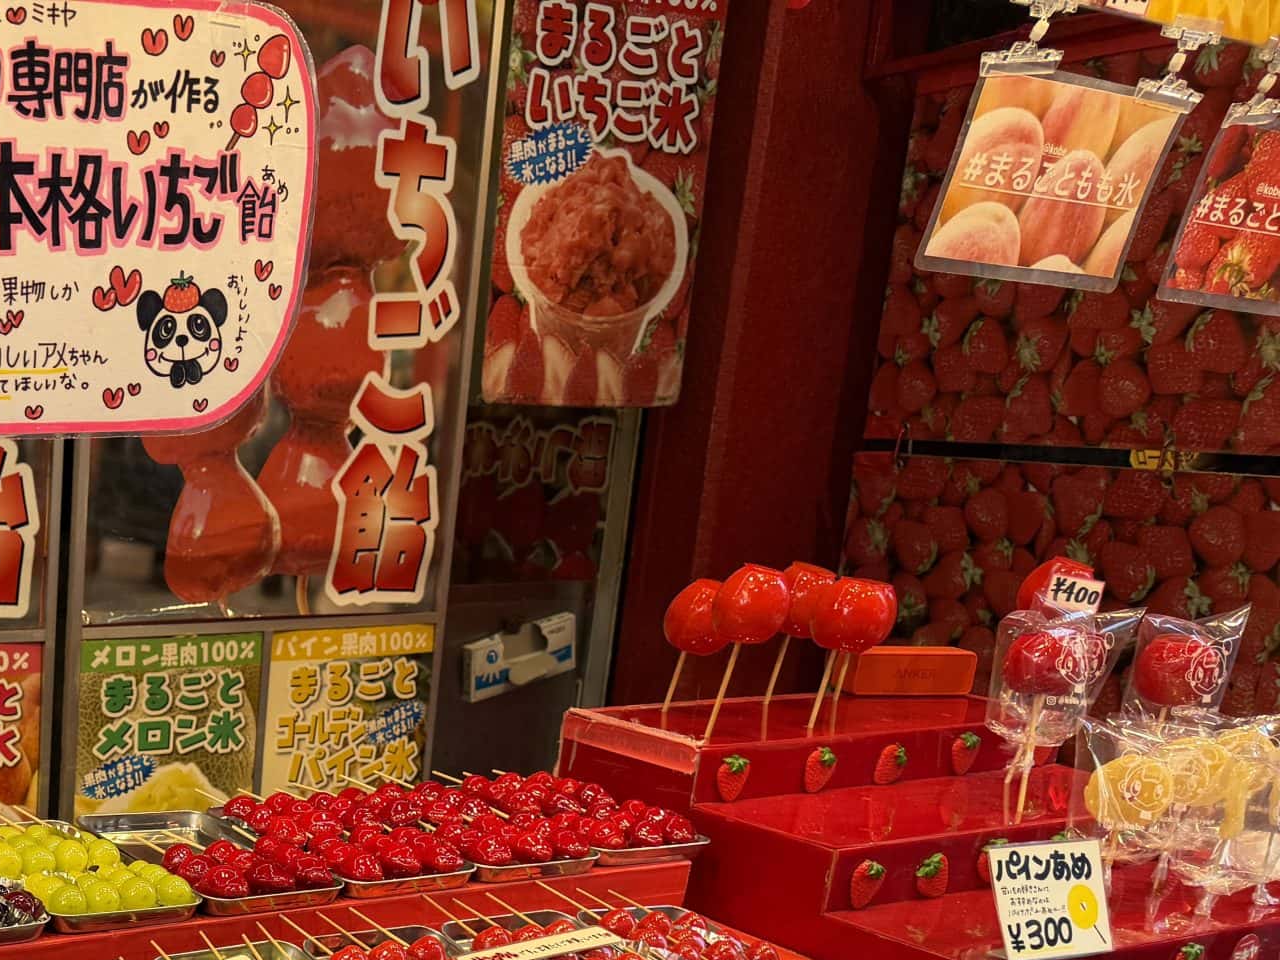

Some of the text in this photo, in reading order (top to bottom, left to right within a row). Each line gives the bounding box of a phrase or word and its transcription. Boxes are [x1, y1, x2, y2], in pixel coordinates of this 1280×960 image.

[32, 7, 77, 27] ミキヤ
[537, 2, 702, 84] まるごと
[526, 68, 699, 154] いちご氷
[963, 152, 1141, 208] #まるごともも氷
[1050, 576, 1100, 606] ¥400
[90, 641, 257, 669] メロン果肉100%
[276, 631, 428, 657] パイン果肉100%
[104, 673, 245, 713] まるごと
[289, 657, 420, 705] まるごと
[94, 710, 245, 758] メロン氷
[276, 705, 367, 749] ゴールデン
[287, 739, 422, 787] パイン氷
[995, 850, 1092, 882] パインあめ
[1007, 916, 1073, 953] ¥300
